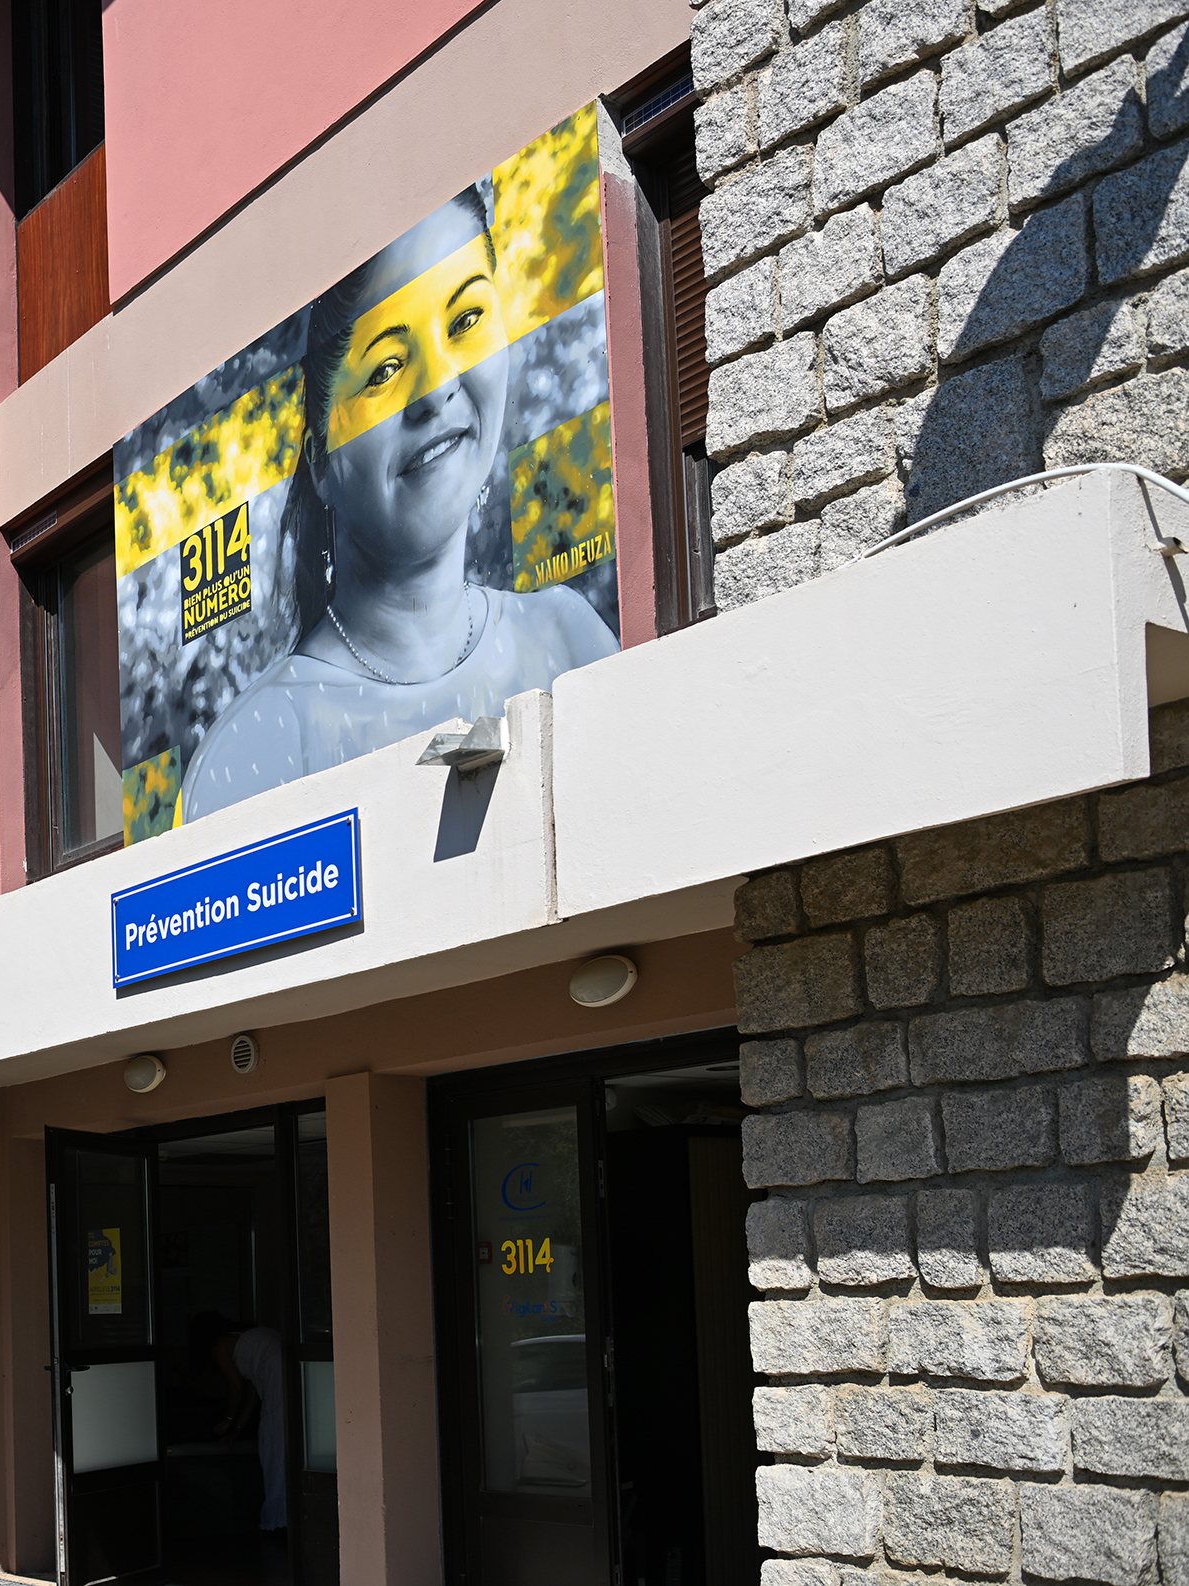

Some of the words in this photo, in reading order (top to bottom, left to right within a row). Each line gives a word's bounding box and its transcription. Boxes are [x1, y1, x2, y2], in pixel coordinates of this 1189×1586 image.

[182, 503, 249, 592] 3114
[535, 552, 569, 587] MAKO
[571, 531, 612, 571] DEUZA
[184, 591, 202, 610] BIEN
[203, 579, 223, 599] PLUS
[223, 565, 250, 587] QU'UN
[185, 616, 219, 640] PRÉVENTION
[219, 611, 228, 622] DU
[228, 599, 251, 618] SUICIDE
[125, 894, 240, 951] Prévention
[247, 860, 339, 912] Suicide
[501, 1237, 551, 1275] 3114
